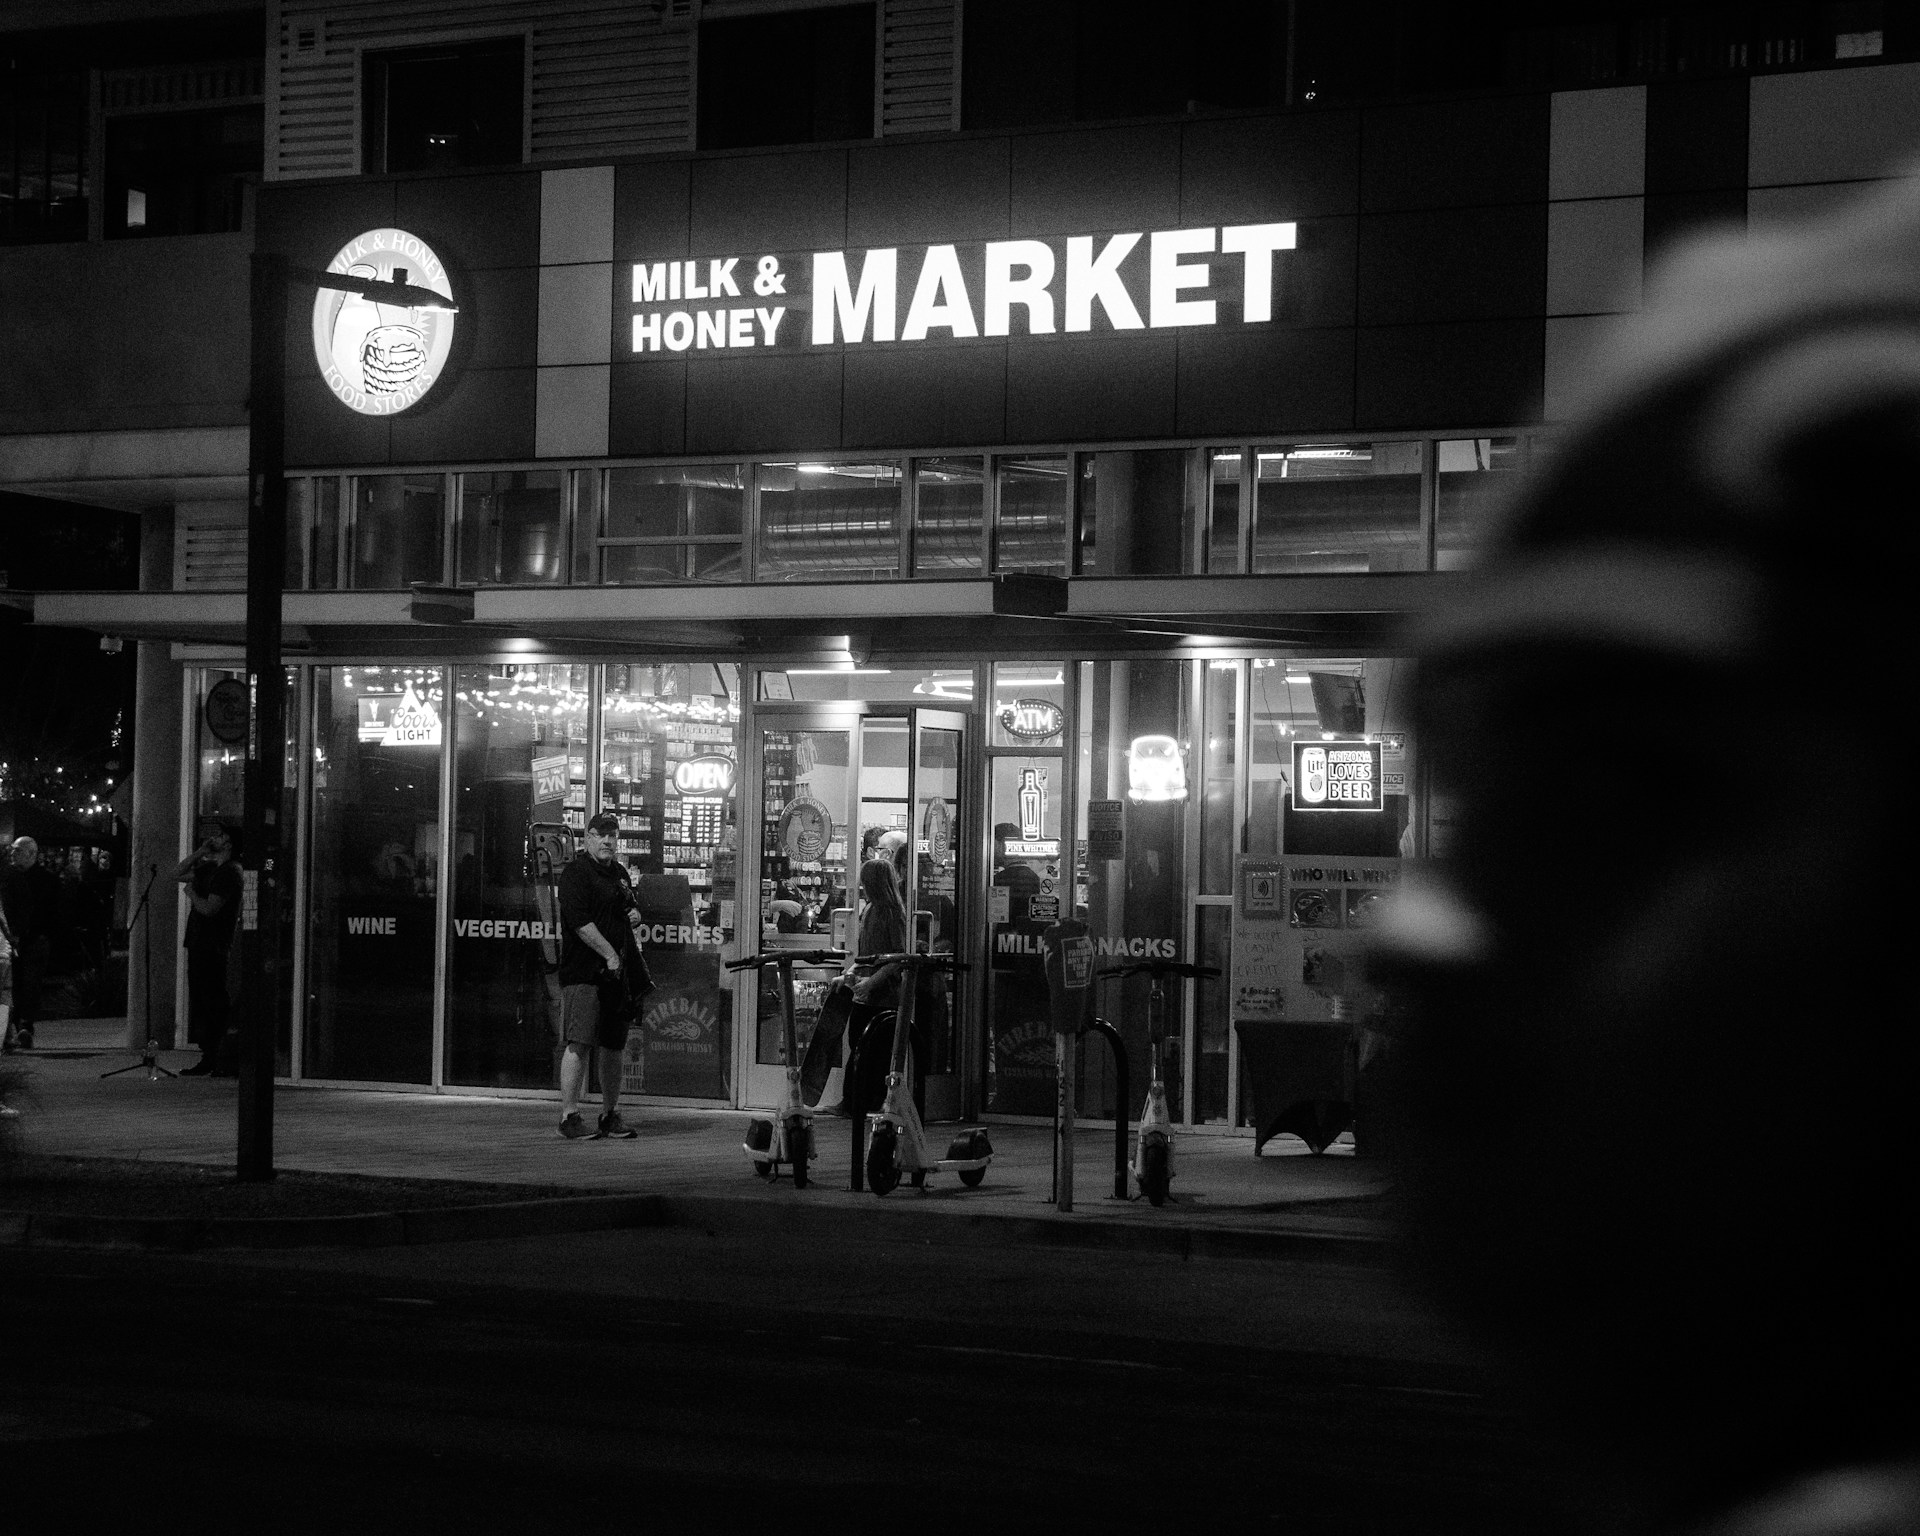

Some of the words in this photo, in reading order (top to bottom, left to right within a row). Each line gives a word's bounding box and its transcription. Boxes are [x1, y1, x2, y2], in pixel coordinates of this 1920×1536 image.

[373, 233, 386, 250] &
[392, 233, 445, 284] HONEY
[633, 258, 740, 302] MILK
[753, 256, 787, 297] &
[812, 223, 1297, 345] MARKET
[633, 307, 786, 353] HONEY
[324, 365, 366, 411] FOOD
[374, 370, 433, 414] STORES
[391, 708, 437, 729] Coors
[1013, 708, 1053, 731] ATM
[396, 729, 431, 741] LIGHT
[1328, 751, 1372, 763] ARIZONA
[677, 762, 728, 789] OPEN
[1328, 764, 1371, 780] LOVES
[538, 773, 565, 795] ZYN
[1328, 781, 1372, 801] BEER
[807, 798, 830, 817] HONEY
[1091, 802, 1121, 812] NOTICE
[1291, 868, 1323, 882] WHO
[1325, 869, 1359, 882] WILL
[347, 916, 397, 936] WINE
[1094, 937, 1176, 958] NACKS
[645, 998, 716, 1032] FIREBALL
